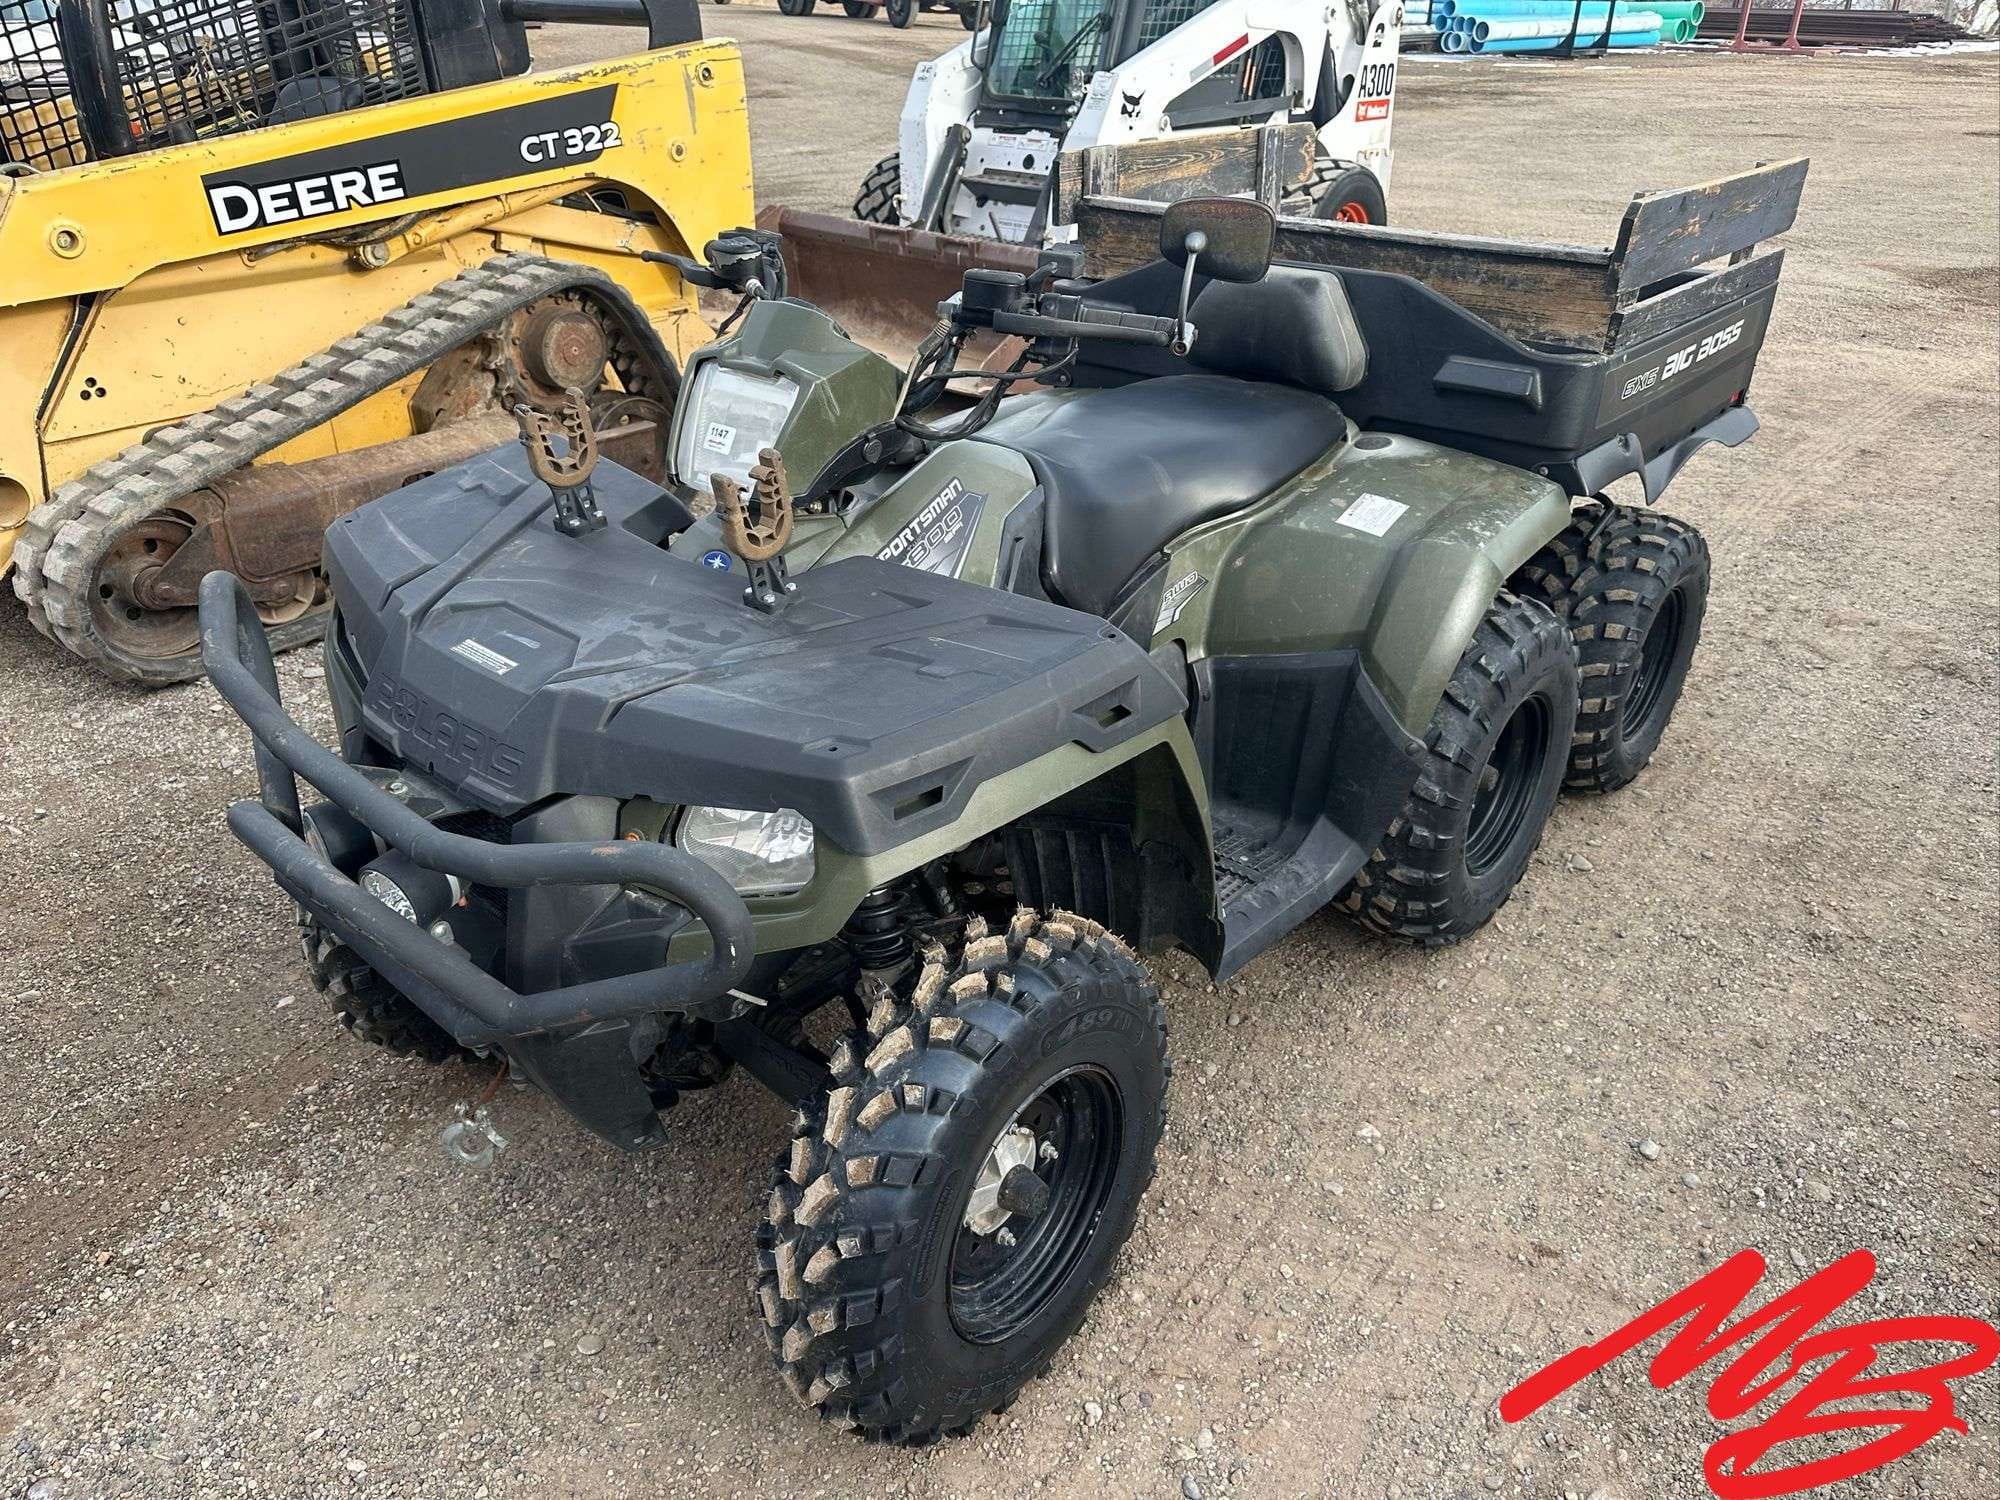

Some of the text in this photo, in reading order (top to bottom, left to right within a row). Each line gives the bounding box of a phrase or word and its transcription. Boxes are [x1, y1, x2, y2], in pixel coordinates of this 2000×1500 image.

[1358, 62, 1396, 98] A300
[519, 121, 623, 163] CT 322
[207, 162, 405, 233] DEERE
[1660, 343, 1697, 381] BIG
[1695, 319, 1745, 362] BOSS
[710, 426, 730, 440] 1147
[877, 478, 963, 561] PORTSMAN
[370, 672, 529, 788] POLARIS
